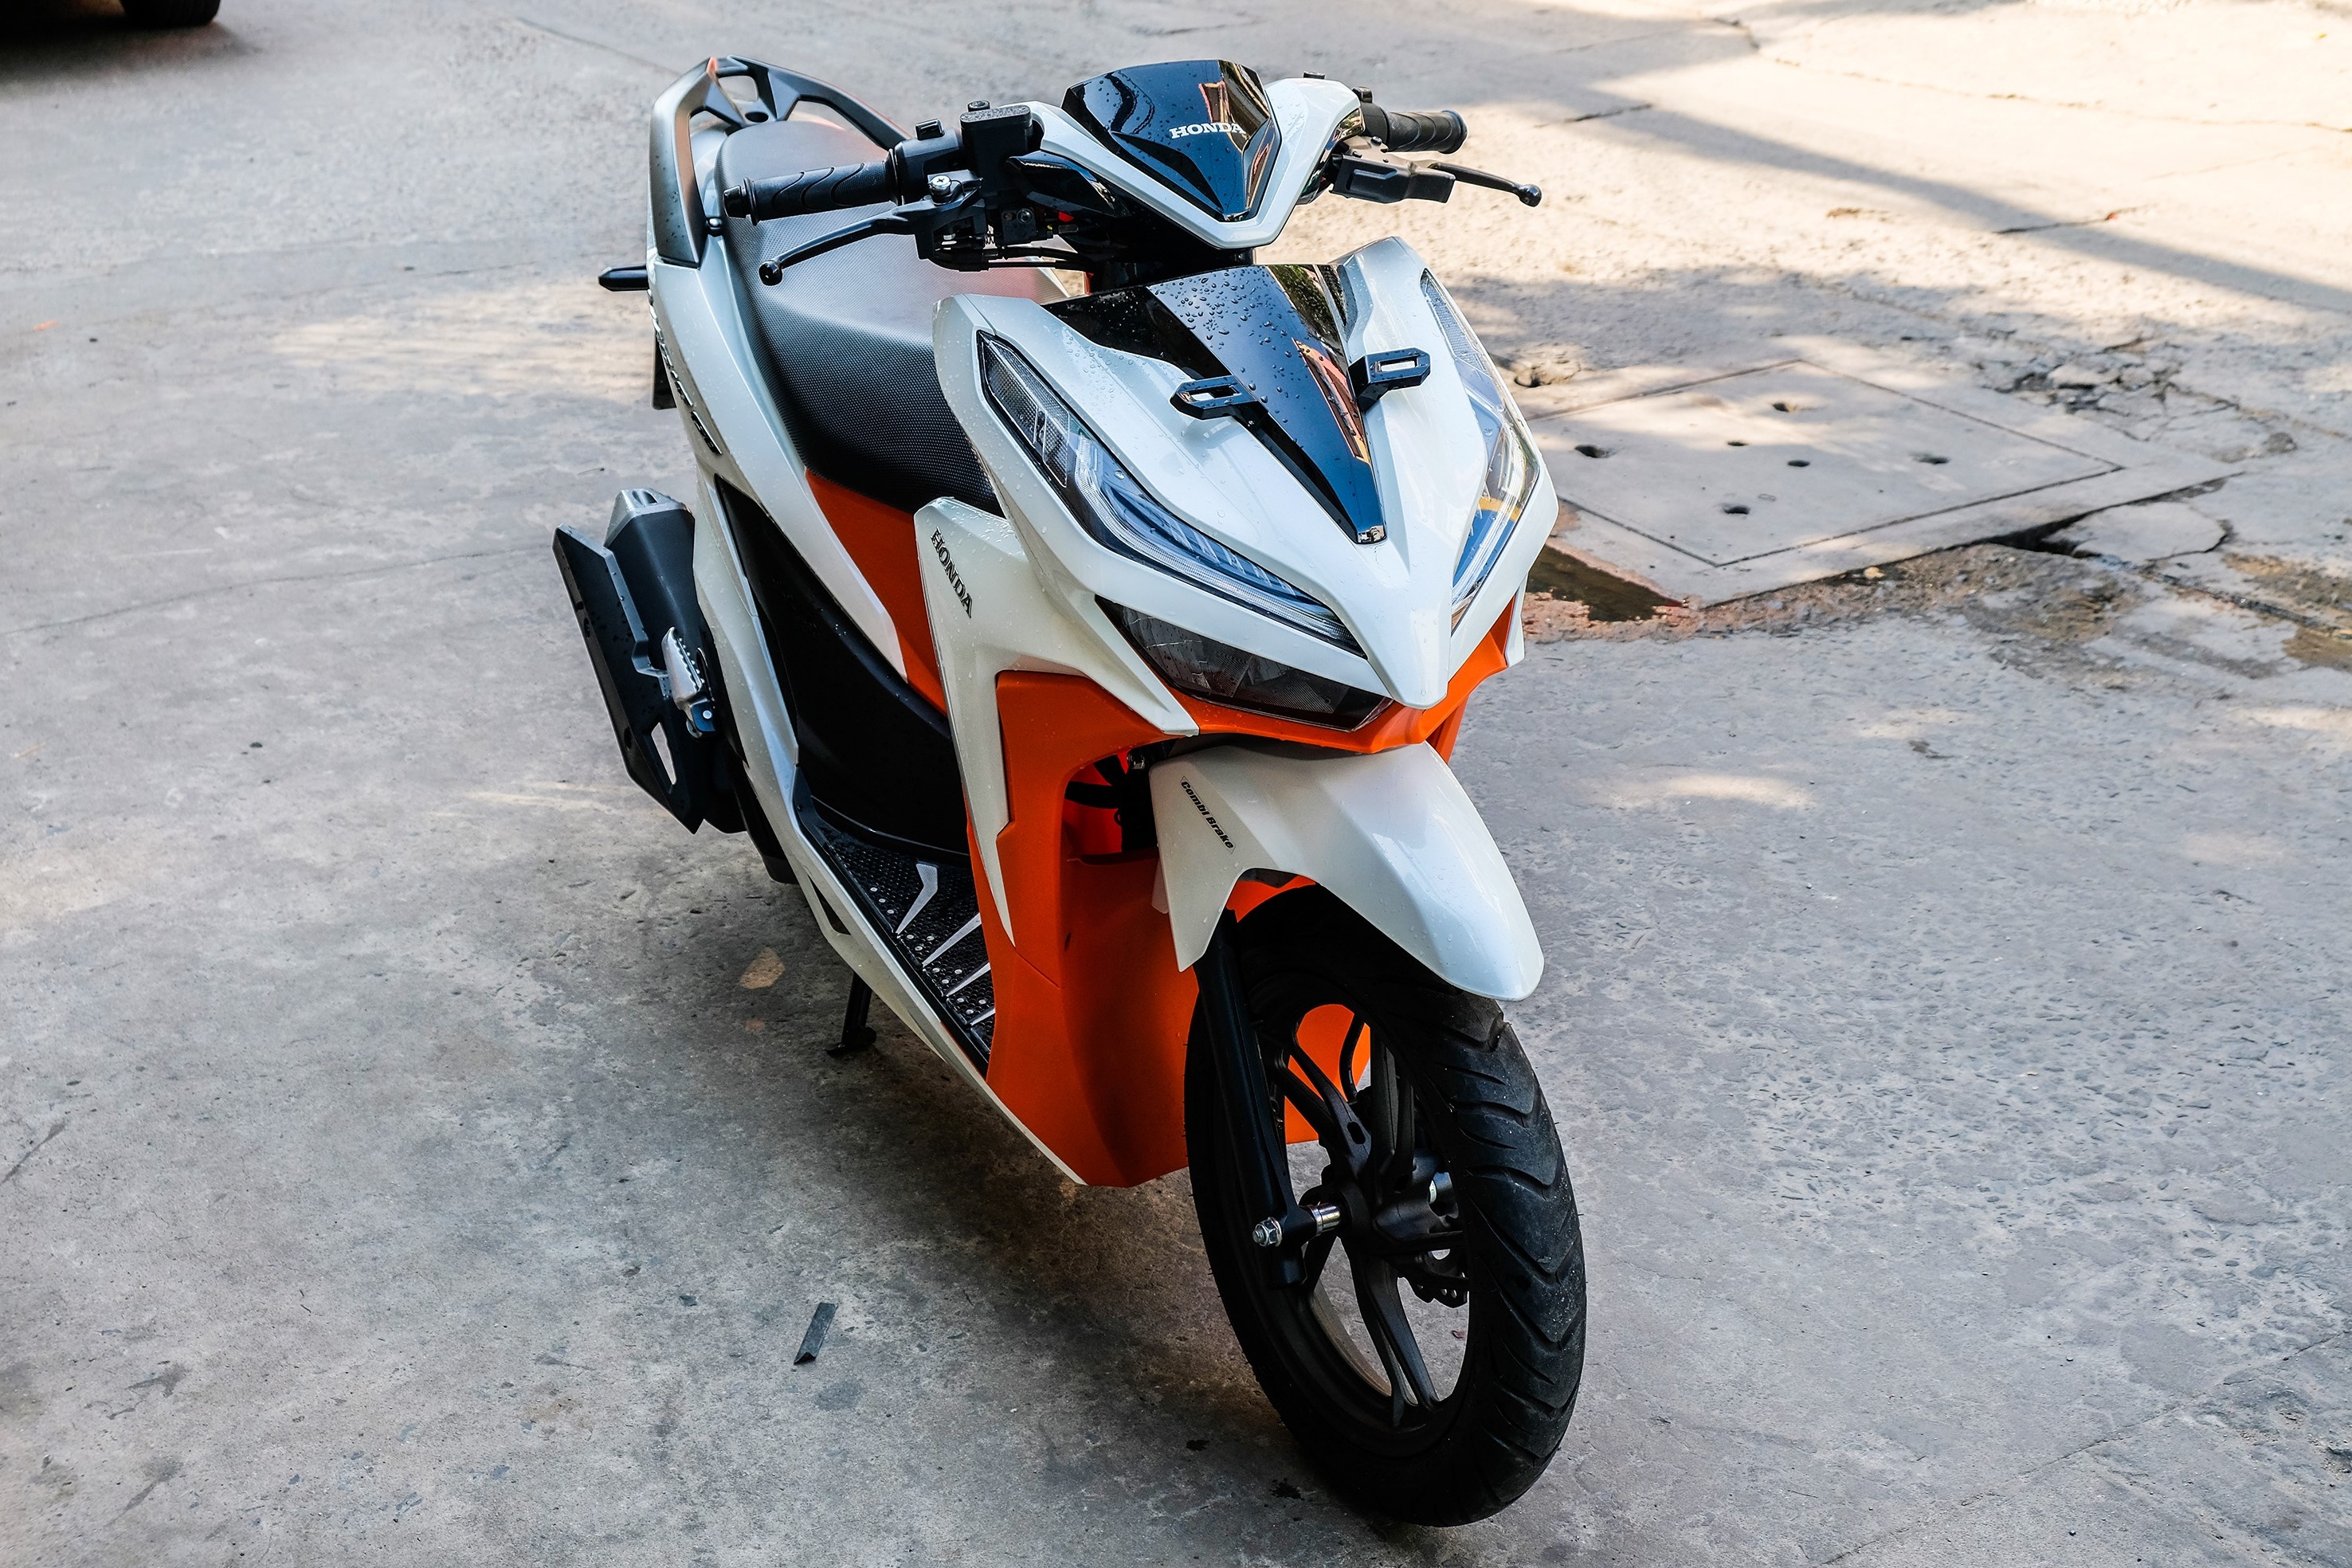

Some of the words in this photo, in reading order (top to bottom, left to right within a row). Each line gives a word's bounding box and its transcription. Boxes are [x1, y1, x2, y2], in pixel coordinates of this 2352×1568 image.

[1169, 122, 1246, 139] HONDA
[930, 526, 972, 619] HONDA
[1181, 781, 1210, 816] Combi
[1205, 817, 1234, 849] Brake
